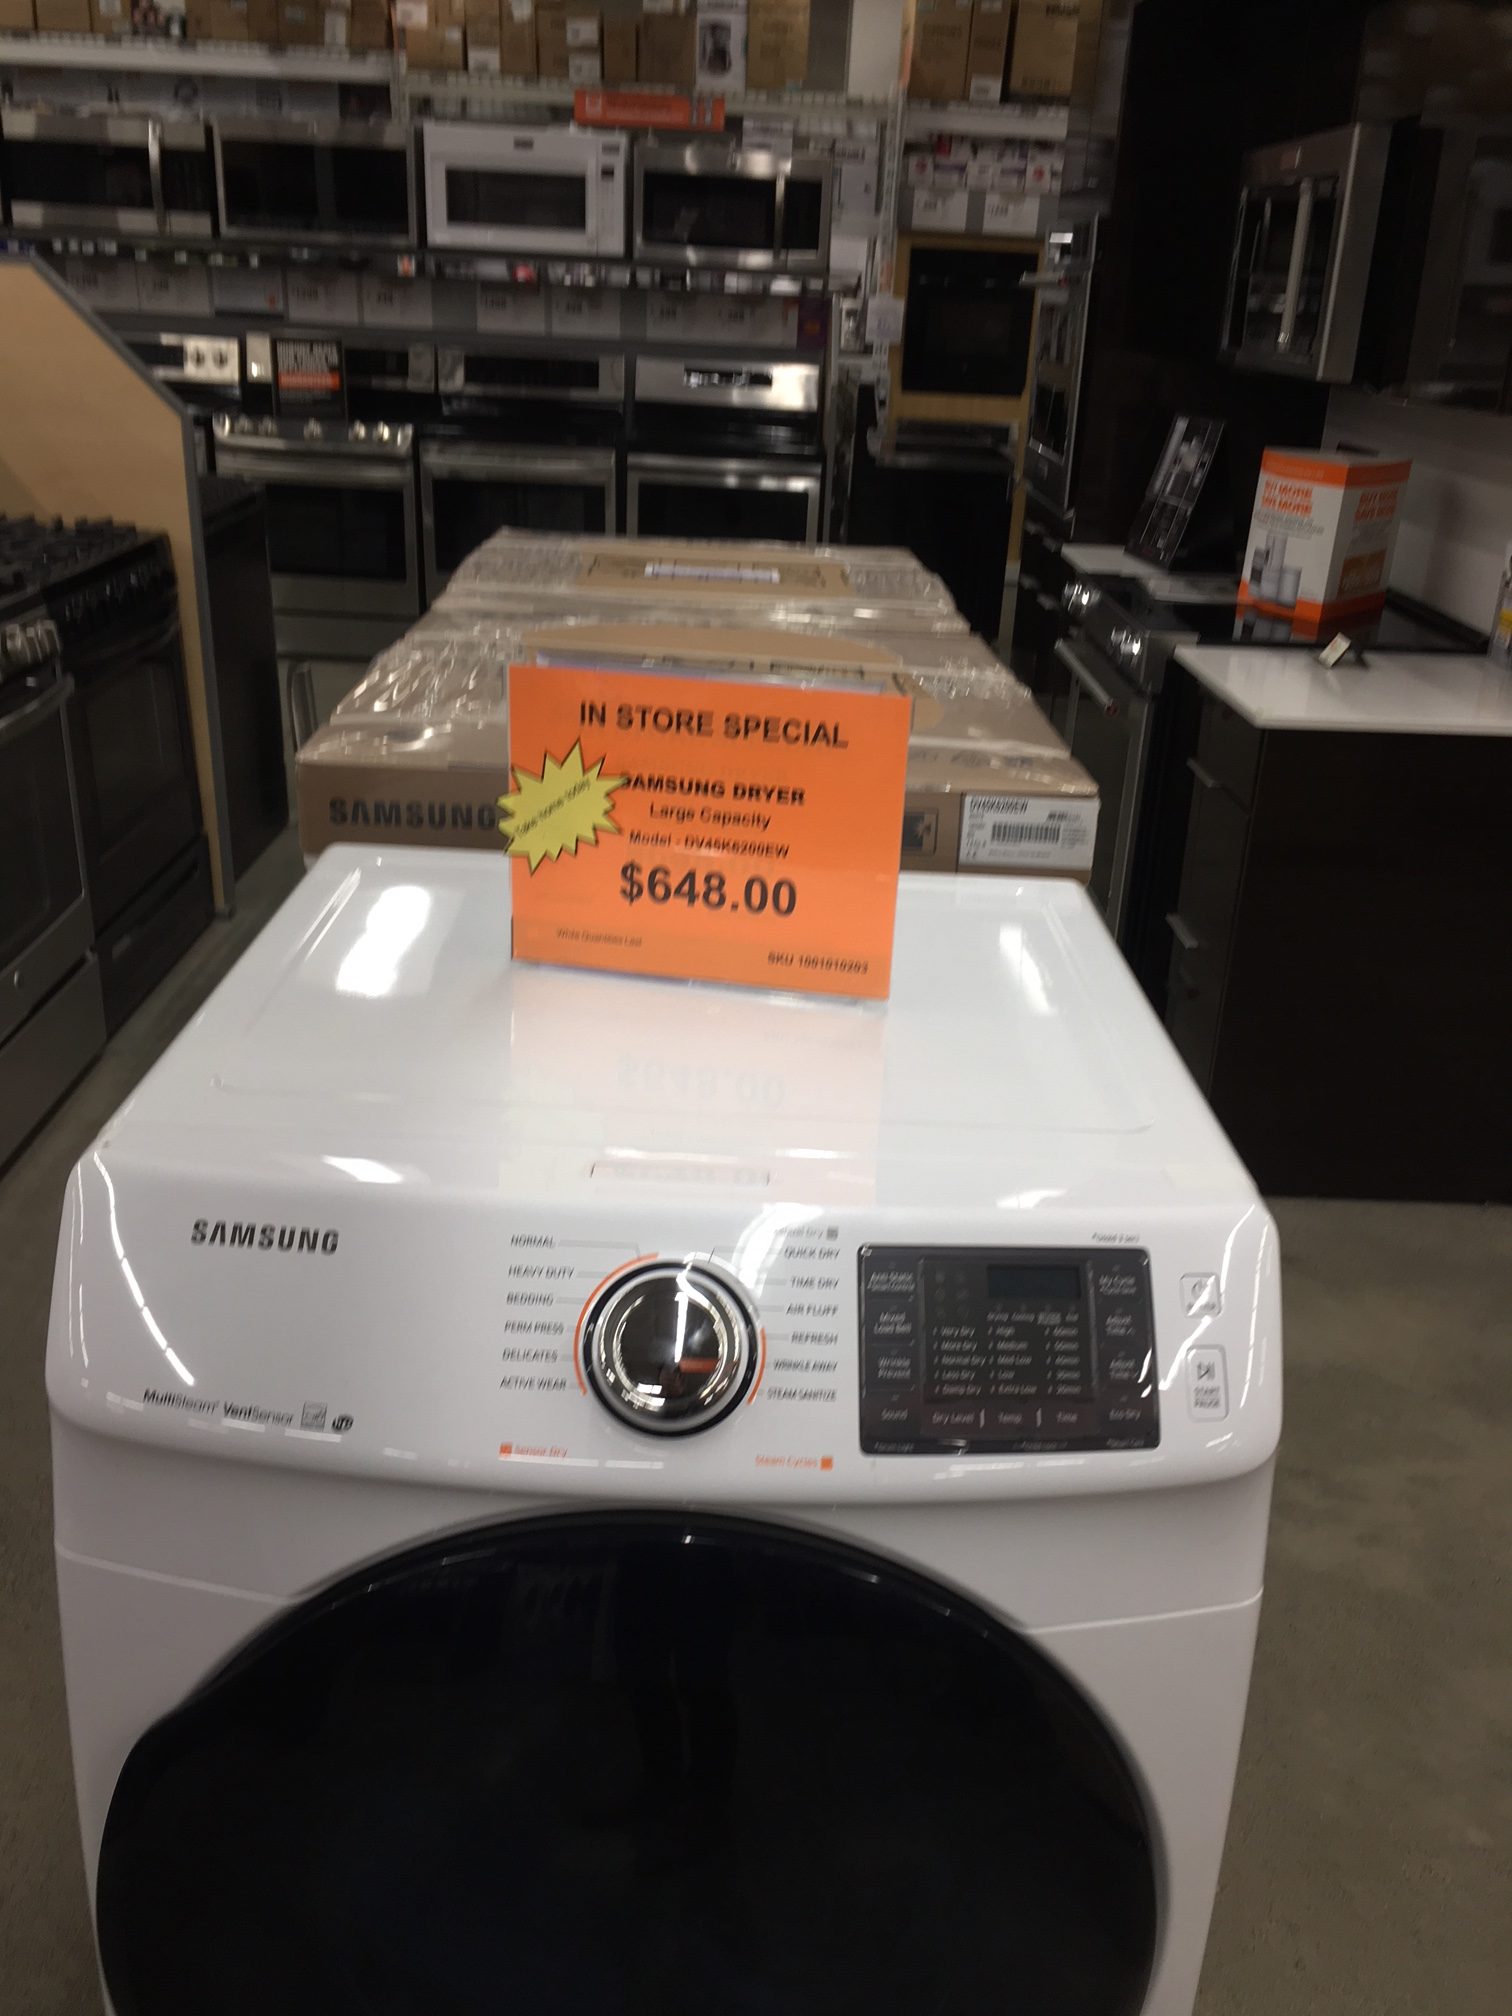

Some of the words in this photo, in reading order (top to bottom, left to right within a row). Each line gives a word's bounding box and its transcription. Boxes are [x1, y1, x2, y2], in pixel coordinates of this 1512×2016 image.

[579, 700, 606, 728] IN
[616, 705, 713, 738] STORE
[723, 713, 849, 749] SPECIAL
[620, 771, 725, 800] SAMSUNG
[732, 781, 806, 807] DRYER
[329, 796, 498, 831] SAMSUNG
[650, 803, 695, 825] Large
[700, 807, 771, 834] Capacity
[629, 829, 672, 848] Model
[619, 860, 798, 918] $648.00
[767, 951, 794, 969] SKU
[191, 1218, 339, 1256] SAMSUNG
[510, 1234, 557, 1249] NORMAL
[818, 1247, 840, 1260] DRY
[508, 1265, 543, 1279] HEAVY
[545, 1266, 575, 1280] DUTY
[790, 1277, 814, 1289] TIME
[816, 1278, 840, 1290] DRY
[506, 1292, 554, 1307] BEDDING
[533, 1321, 564, 1335] PRESS
[502, 1348, 558, 1363] DELICATES
[537, 1377, 567, 1391] WEAR
